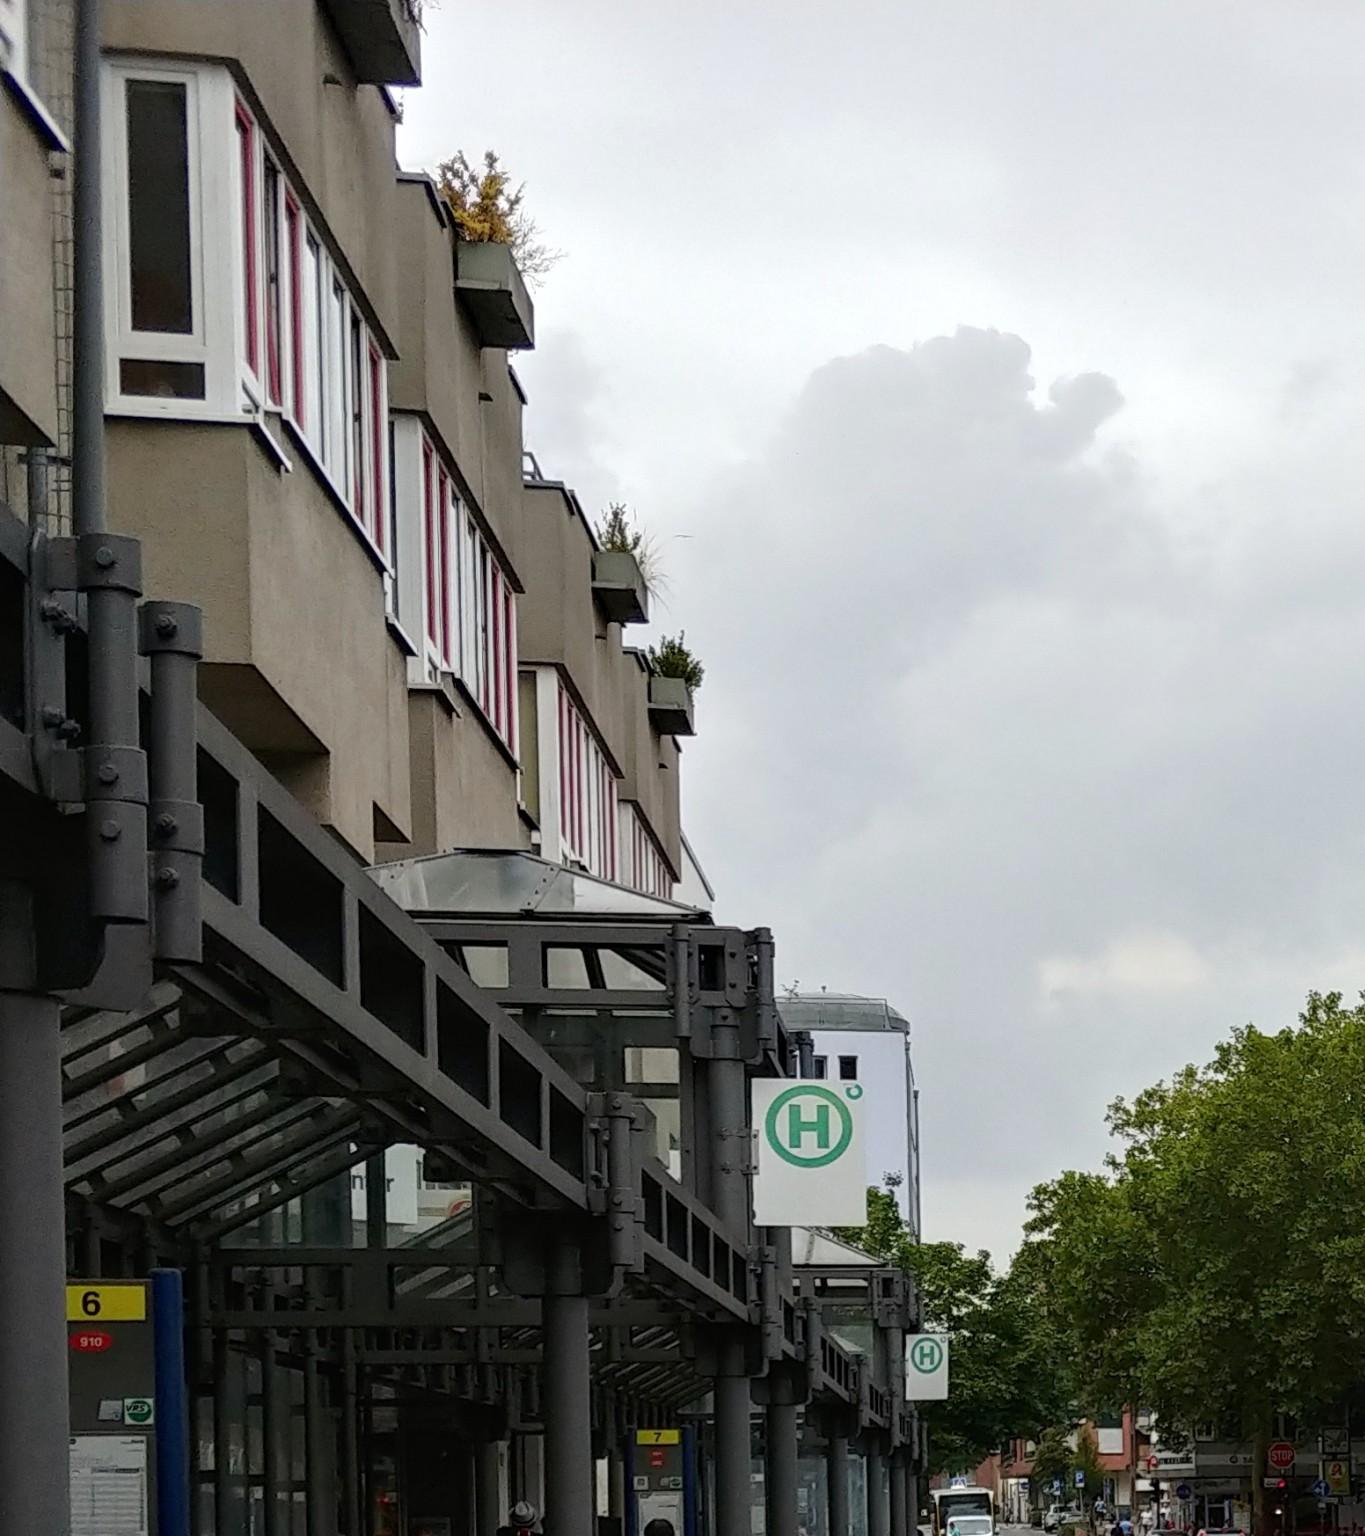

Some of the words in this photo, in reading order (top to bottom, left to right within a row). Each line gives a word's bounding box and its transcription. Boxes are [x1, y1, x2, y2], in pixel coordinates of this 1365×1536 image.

[789, 1104, 829, 1149] H
[81, 1291, 101, 1316] 6
[80, 1337, 103, 1347] 910
[919, 1345, 935, 1366] H
[653, 1433, 662, 1442] 7
[1271, 1451, 1293, 1461] STOP
